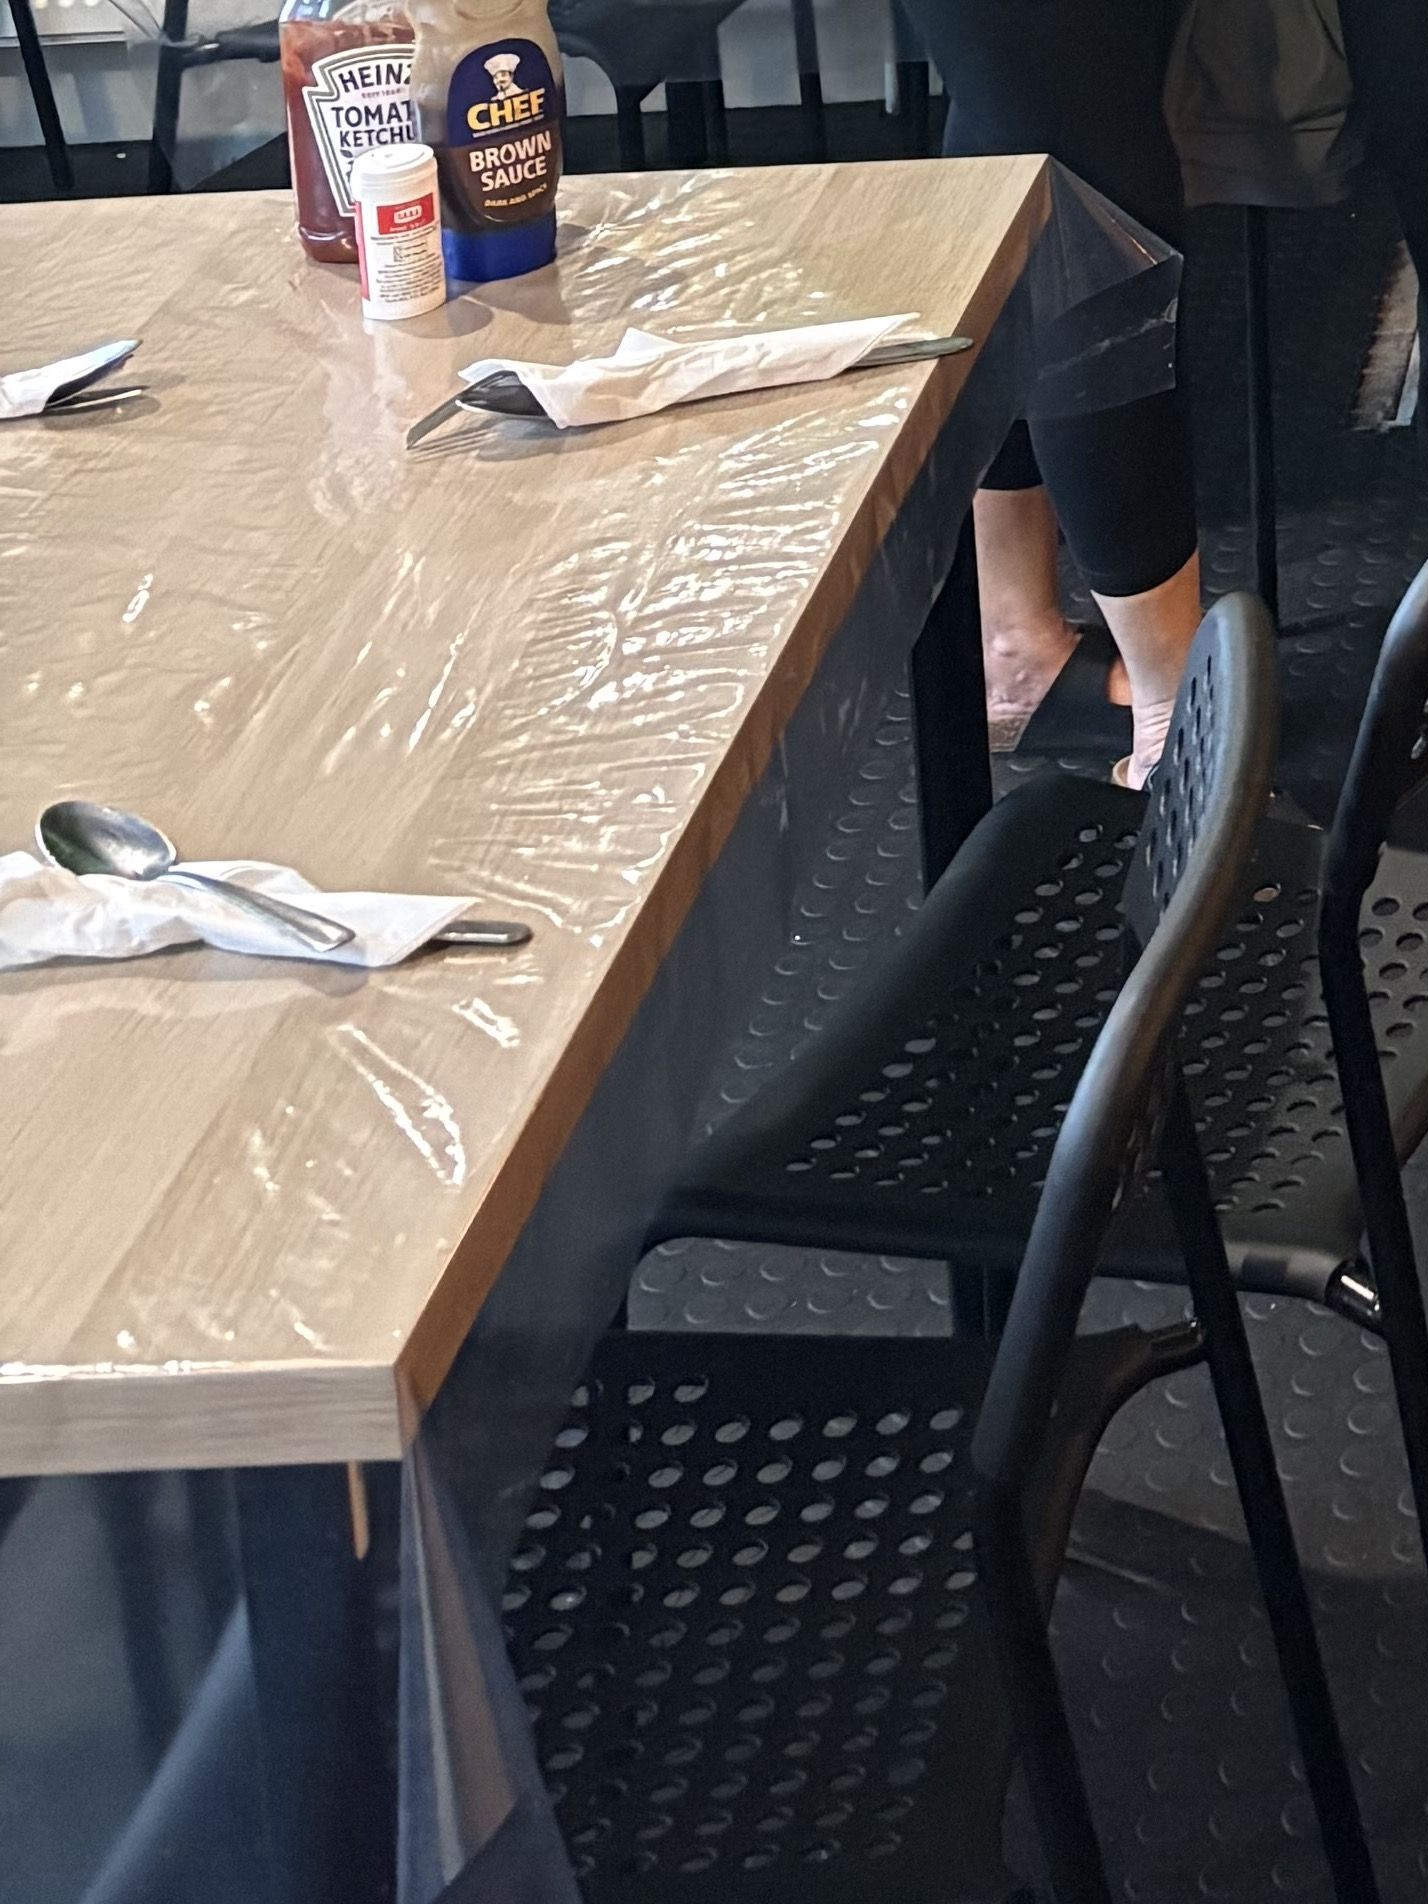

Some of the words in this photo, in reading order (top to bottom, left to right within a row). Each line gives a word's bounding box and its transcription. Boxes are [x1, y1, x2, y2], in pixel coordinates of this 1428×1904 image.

[331, 100, 412, 128] TOMAT
[467, 88, 545, 130] CHEF
[340, 123, 416, 148] KETCHU
[469, 130, 552, 173] BROWN
[480, 156, 548, 192] SAUCE
